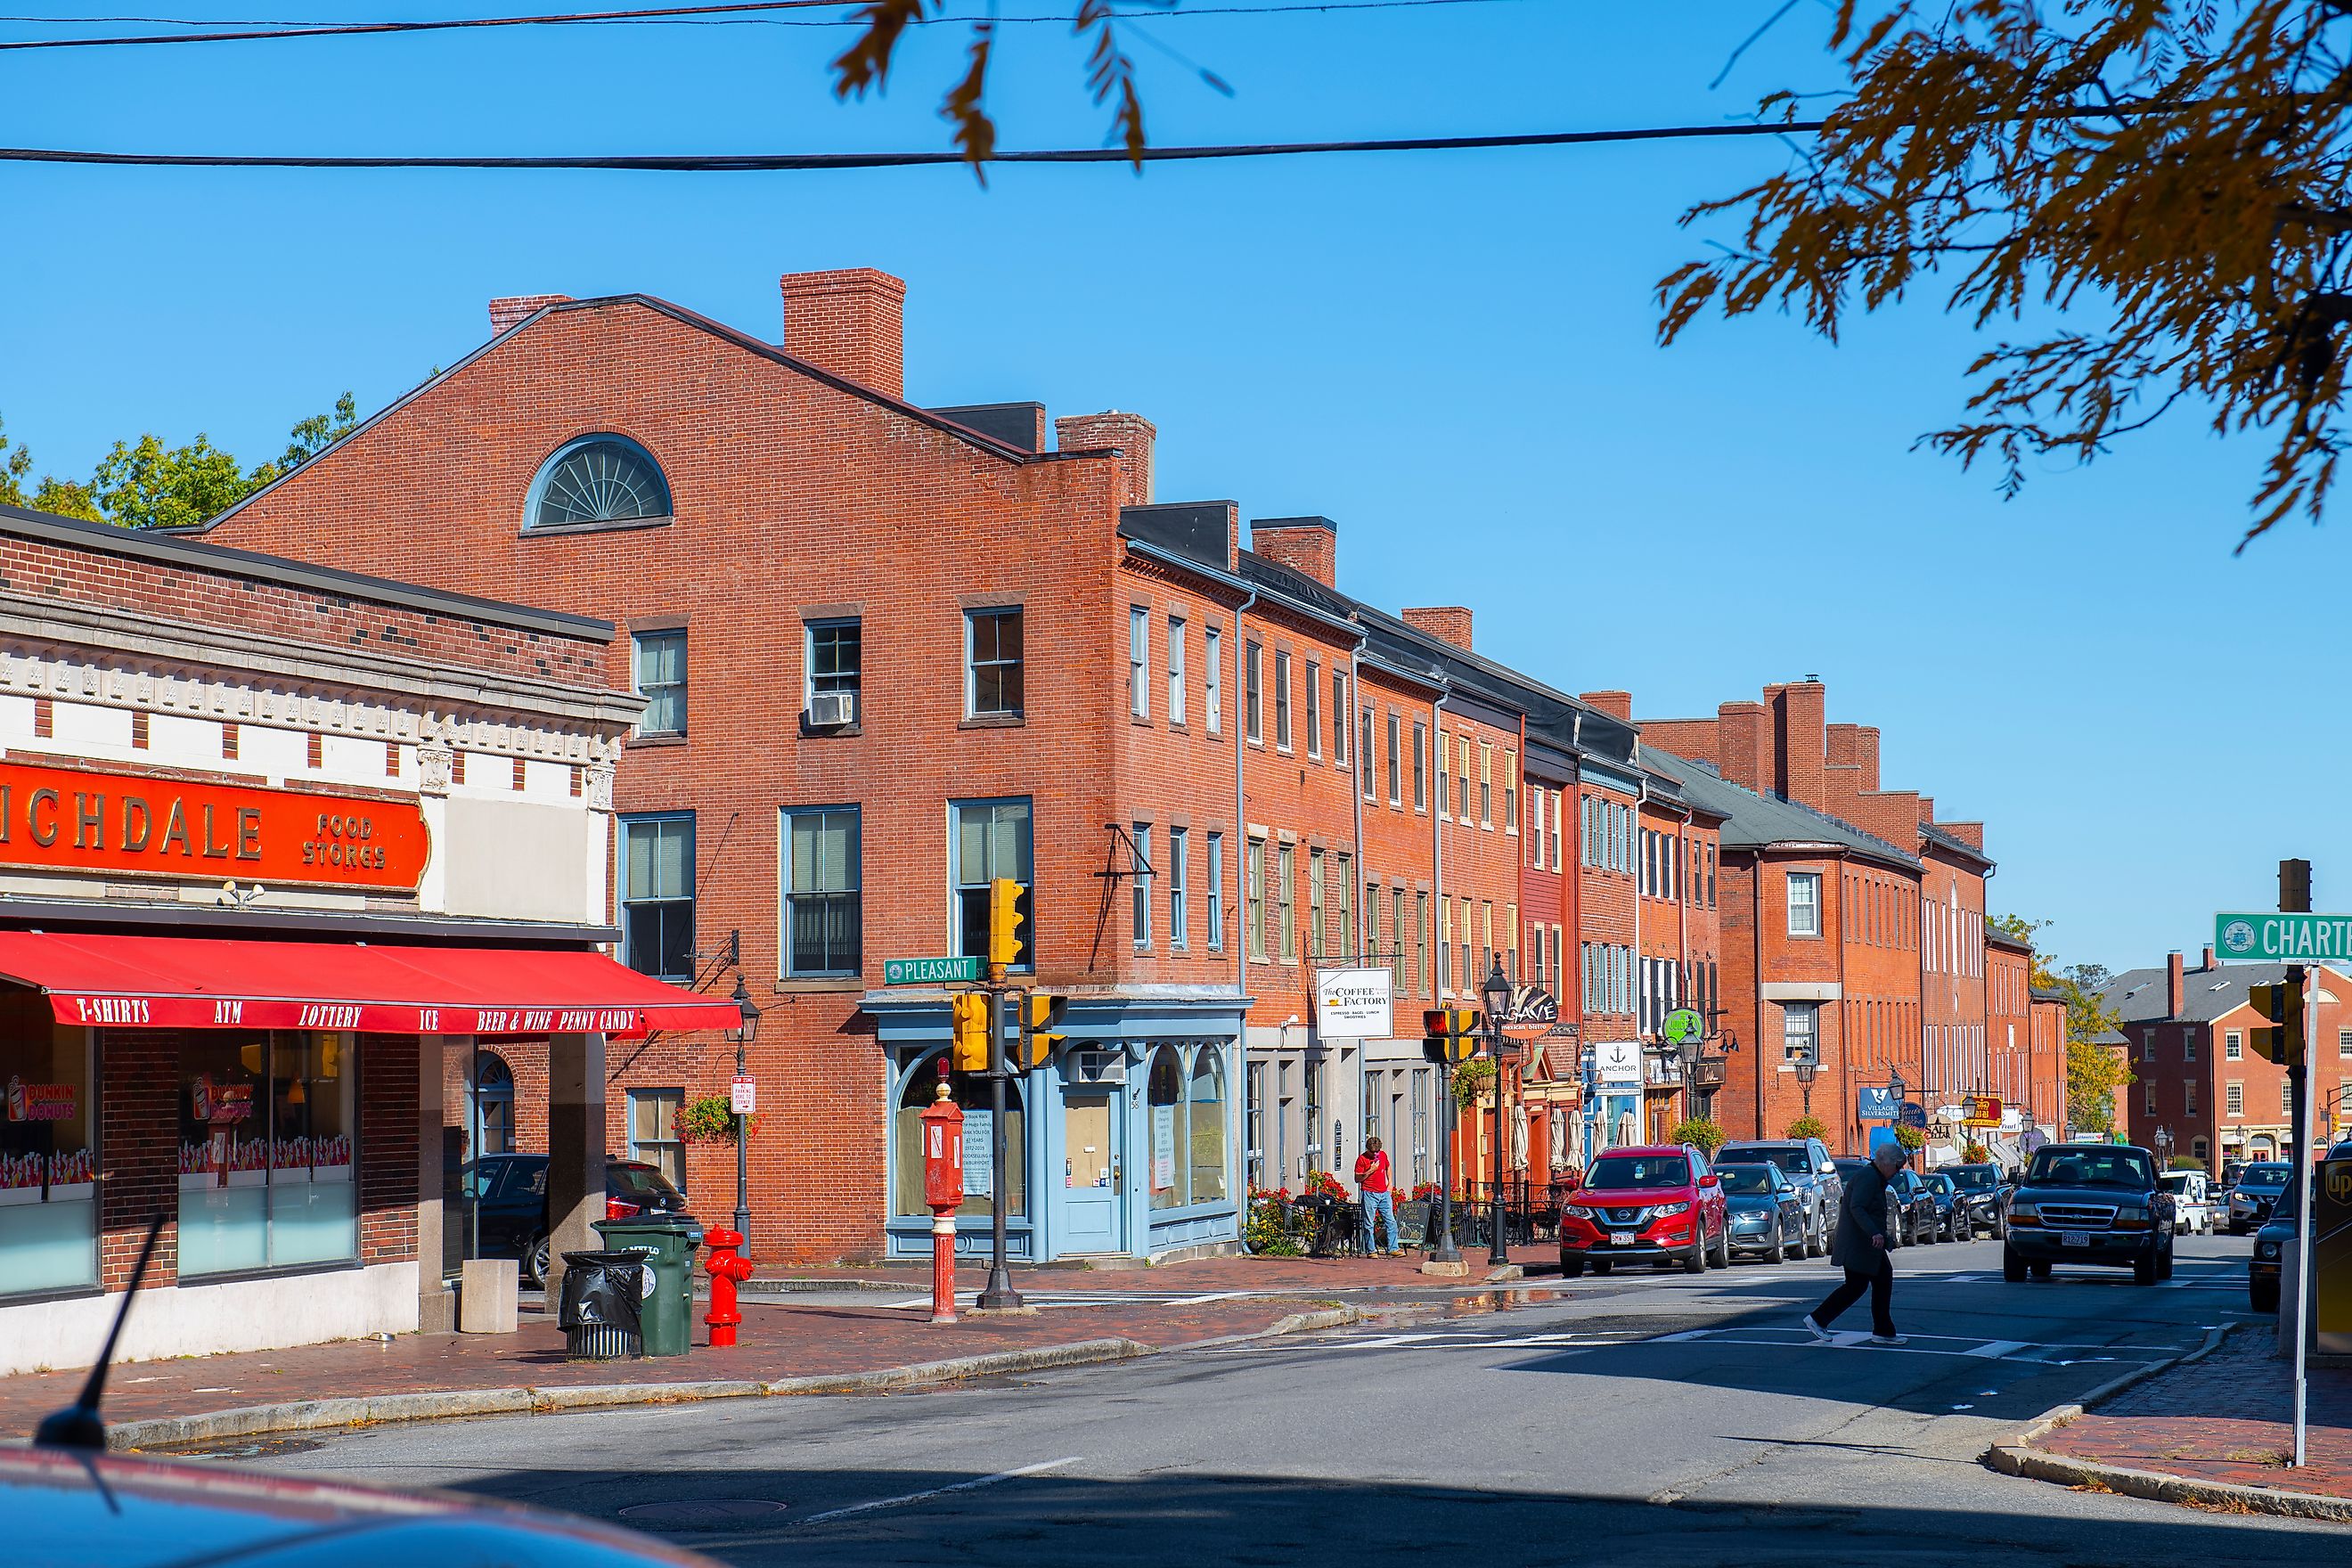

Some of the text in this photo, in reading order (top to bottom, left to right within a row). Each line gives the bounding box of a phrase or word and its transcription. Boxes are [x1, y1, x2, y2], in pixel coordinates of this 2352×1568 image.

[316, 813, 372, 839] FOOD
[302, 841, 387, 870] STORES
[905, 960, 984, 980] PLEASANT ST
[1323, 987, 1336, 996] The
[1335, 987, 1375, 997] COFFEE
[1343, 997, 1388, 1007] FACTORY
[76, 998, 635, 1032] T-SHIRTS ATM LOTTERY ICE BEER & WINE PENNY CANDY
[28, 1084, 77, 1101] DUNKIN'
[29, 1103, 75, 1121] DONUTS
[1924, 1125, 1951, 1134] SALT
